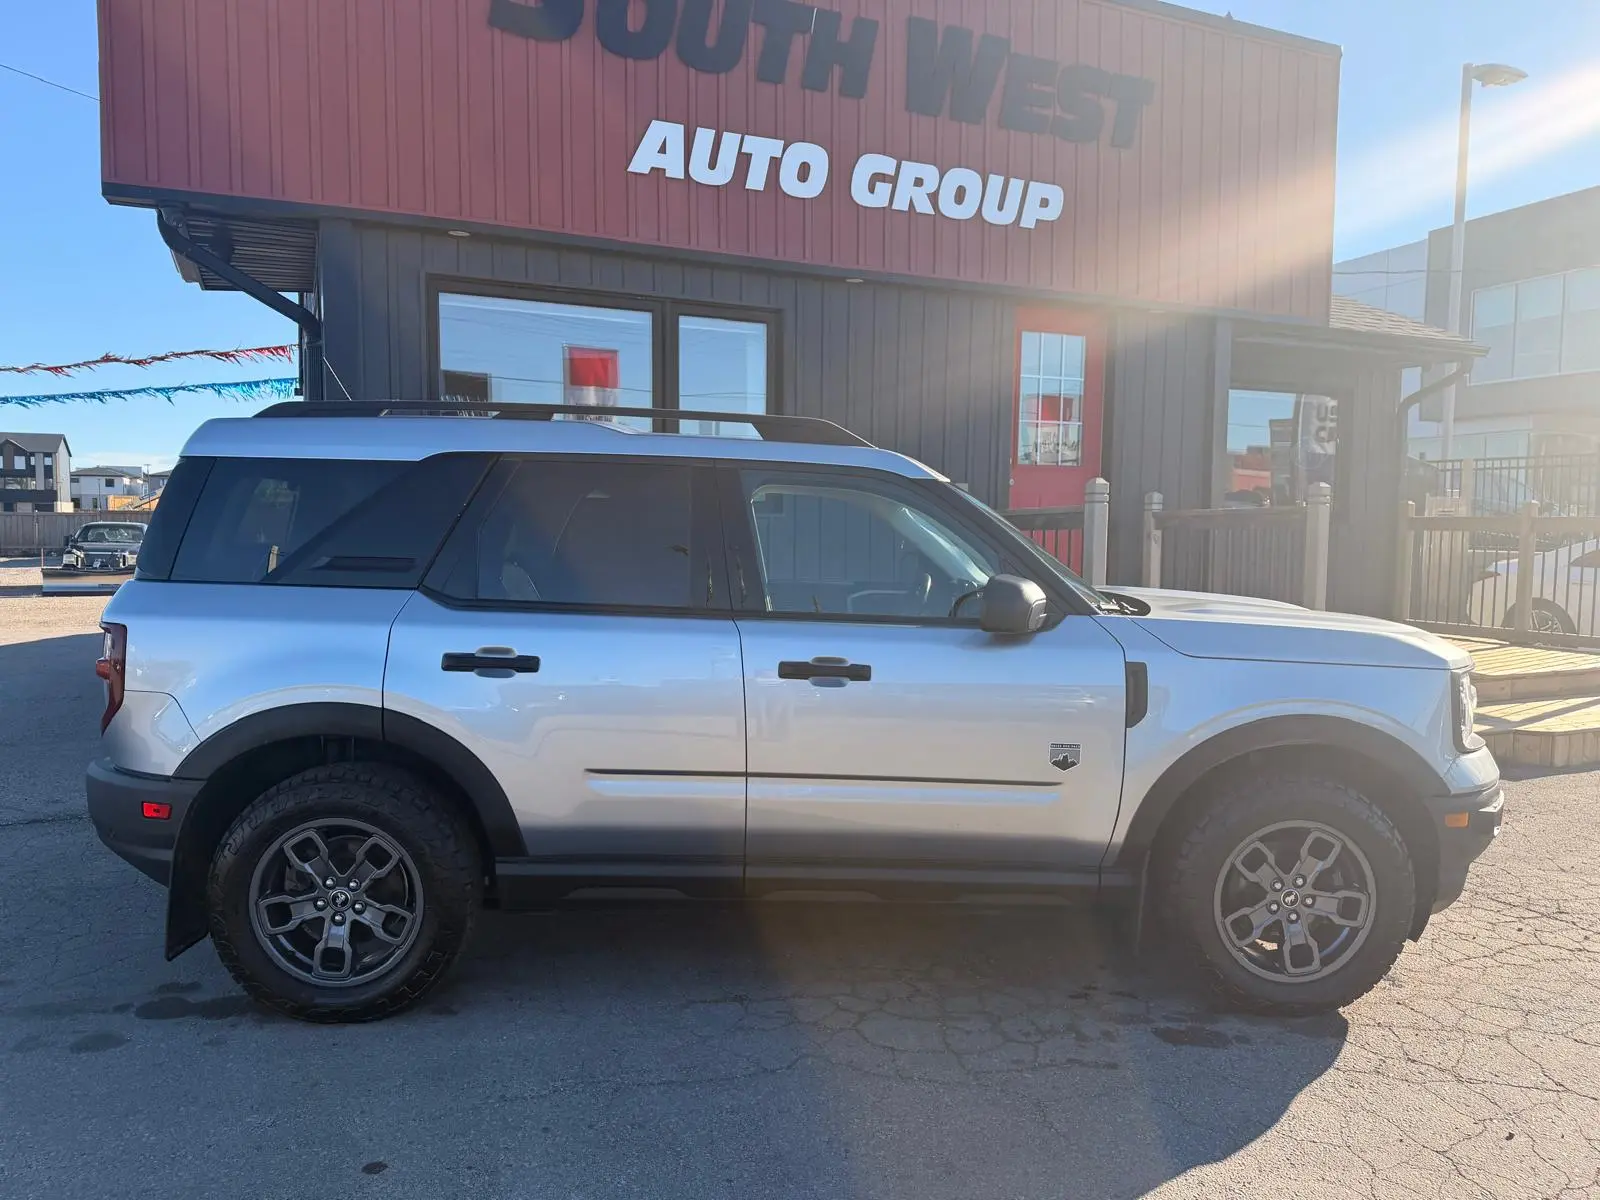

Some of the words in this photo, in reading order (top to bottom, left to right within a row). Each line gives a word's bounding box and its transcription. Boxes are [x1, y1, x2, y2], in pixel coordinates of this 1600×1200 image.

[904, 15, 1155, 149] WEST
[627, 119, 829, 199] AUTO
[850, 153, 1064, 229] GROUP
